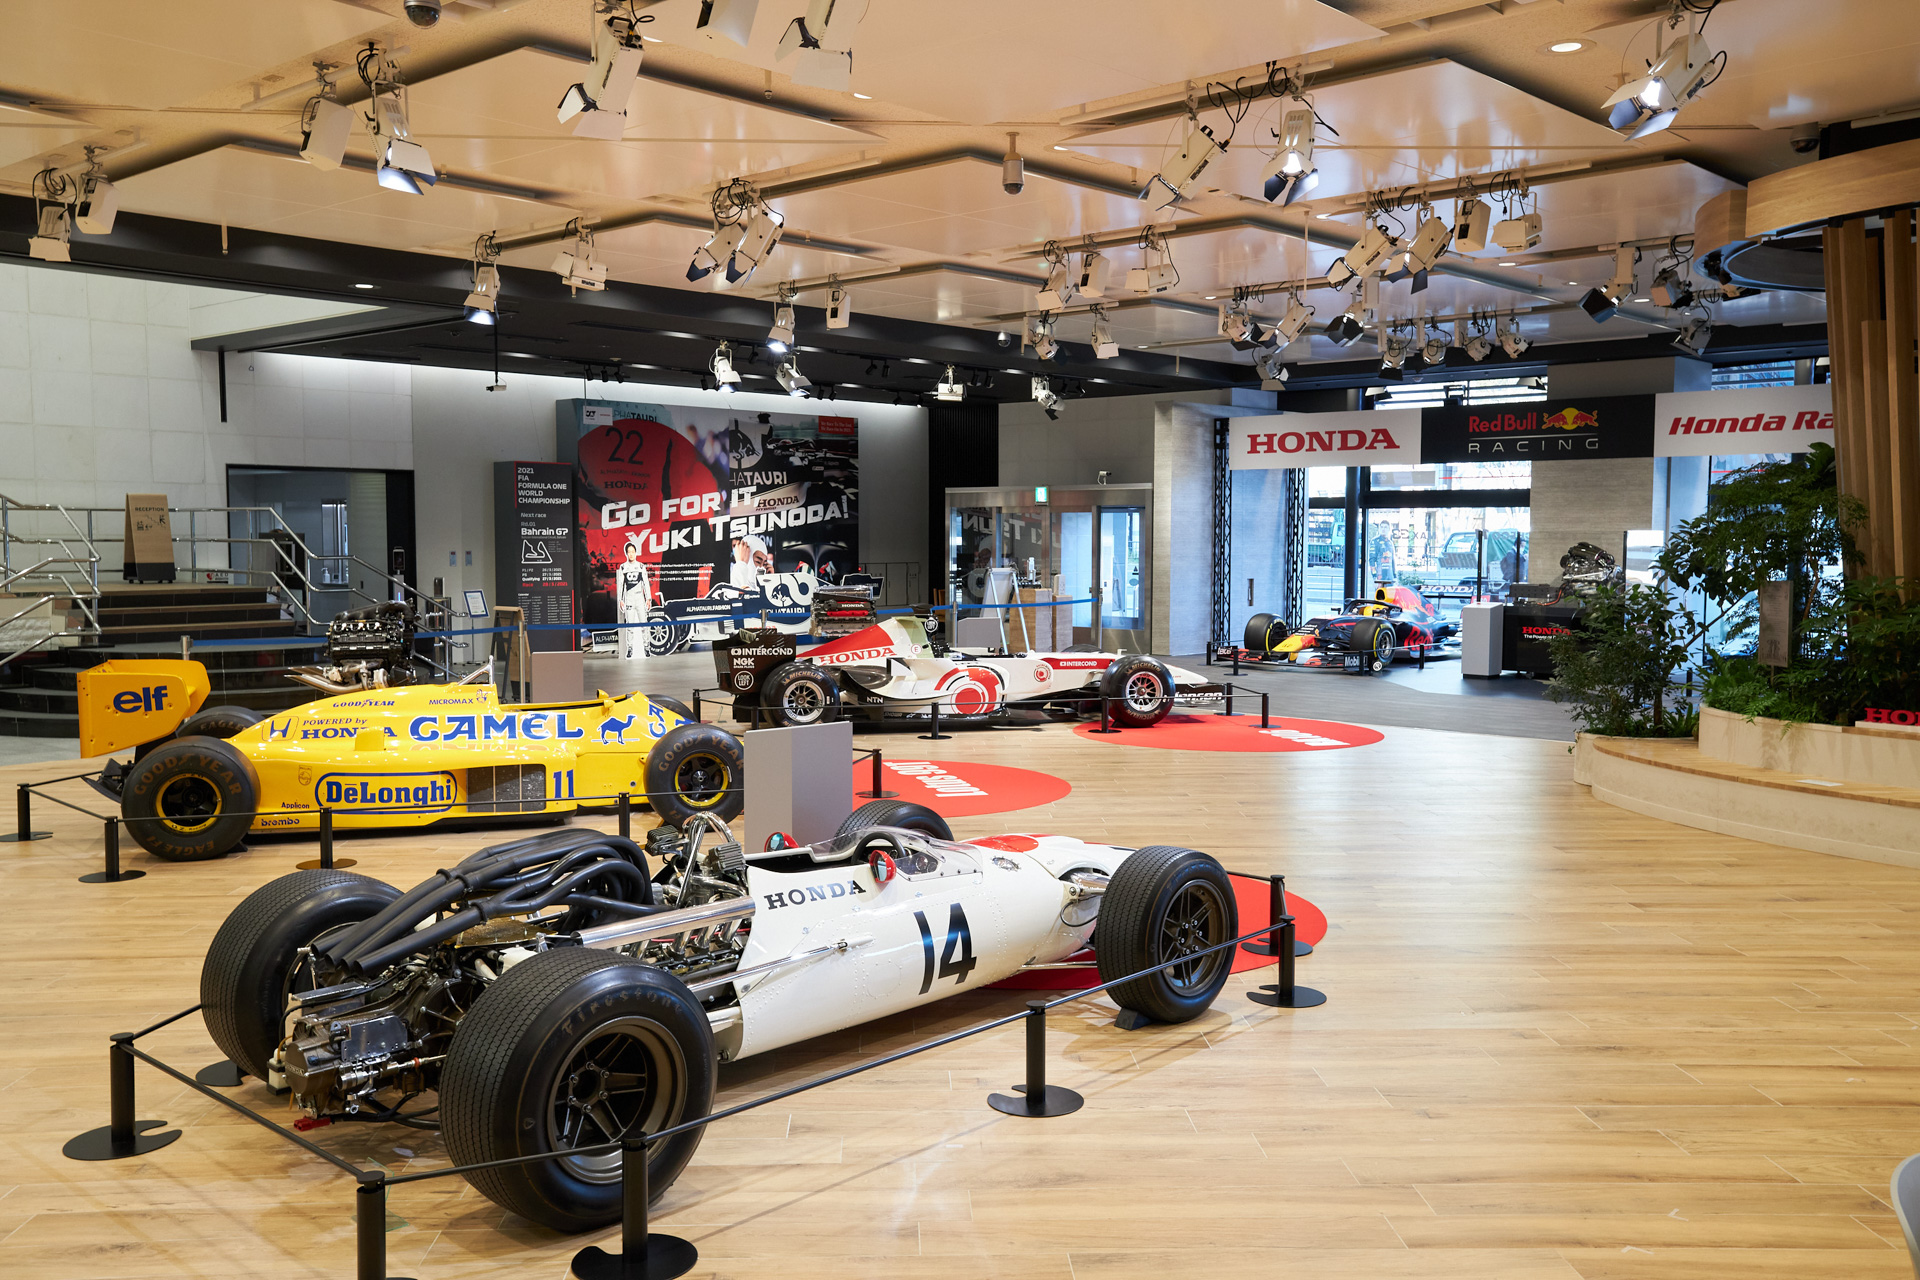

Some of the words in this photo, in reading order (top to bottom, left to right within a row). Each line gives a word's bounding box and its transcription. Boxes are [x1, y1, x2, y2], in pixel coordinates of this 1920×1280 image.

[1469, 414, 1502, 432] Red
[1504, 412, 1537, 431] Bull
[1668, 413, 1787, 435] Honda
[605, 427, 643, 465] 22
[1247, 428, 1400, 454] HONDA
[1468, 438, 1599, 454] RACING
[604, 481, 648, 490] HONDA
[757, 495, 799, 508] HONDA
[521, 527, 555, 535] Bahrain
[743, 647, 793, 655] INTERCOND
[820, 647, 897, 667] HONDA
[789, 671, 822, 680] MICHELIN
[113, 685, 168, 713] elf
[866, 696, 884, 704] NTN
[303, 718, 353, 726] POWERED
[355, 718, 367, 726] by
[1864, 707, 1920, 726] HO
[301, 727, 397, 739] HONA
[409, 713, 584, 742] CAMEL
[552, 769, 574, 798] 11
[281, 801, 309, 809] Applicon
[261, 818, 300, 827] brembo
[764, 879, 866, 911] HONDA
[912, 902, 977, 996] 14
